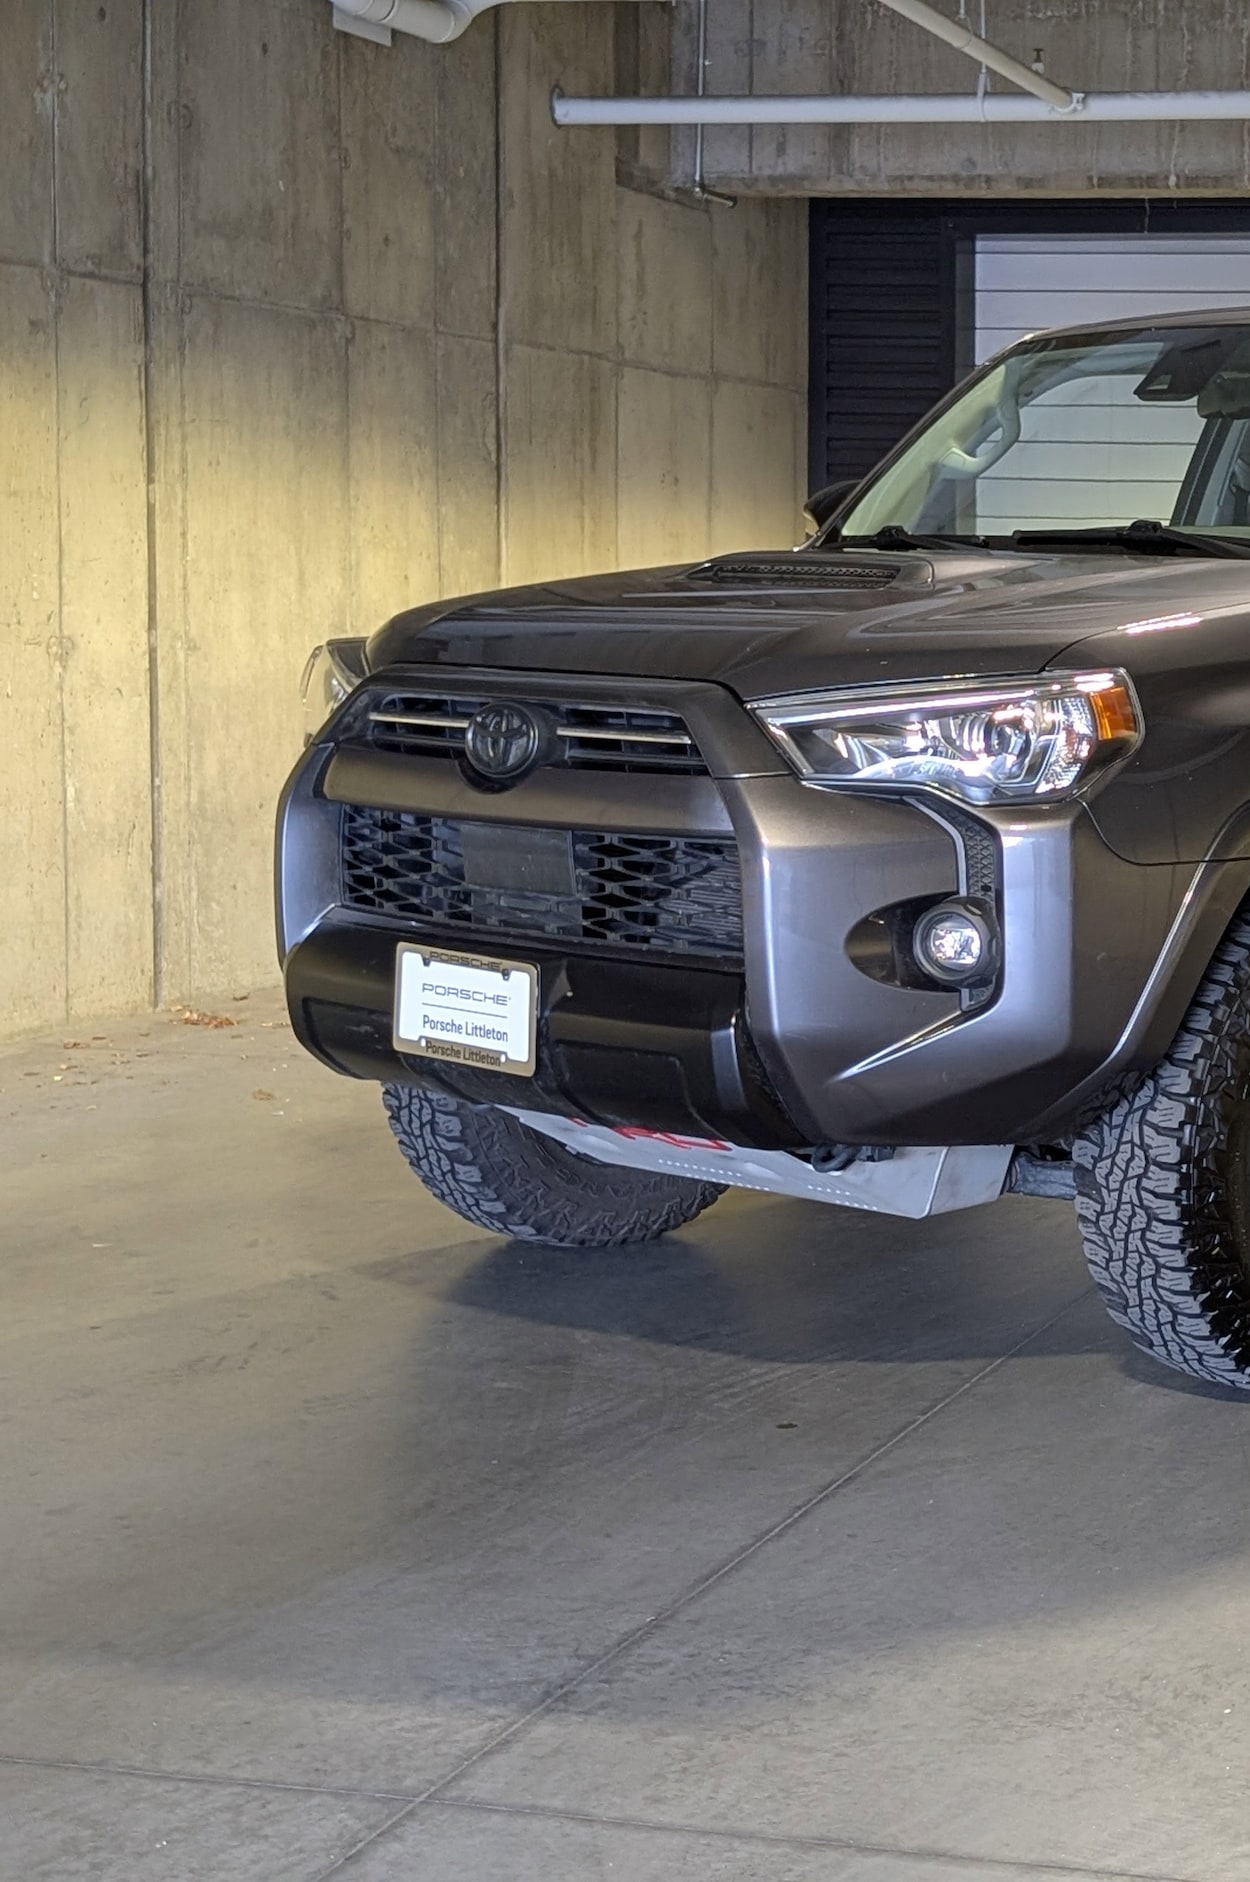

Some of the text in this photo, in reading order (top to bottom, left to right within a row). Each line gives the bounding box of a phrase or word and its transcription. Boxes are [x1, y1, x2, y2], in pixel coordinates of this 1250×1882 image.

[429, 950, 503, 973] PORSCHE
[421, 982, 509, 1007] PORSCHE
[422, 1014, 509, 1043] Porsche Littleton
[425, 1040, 501, 1067] Porsche Littleton
